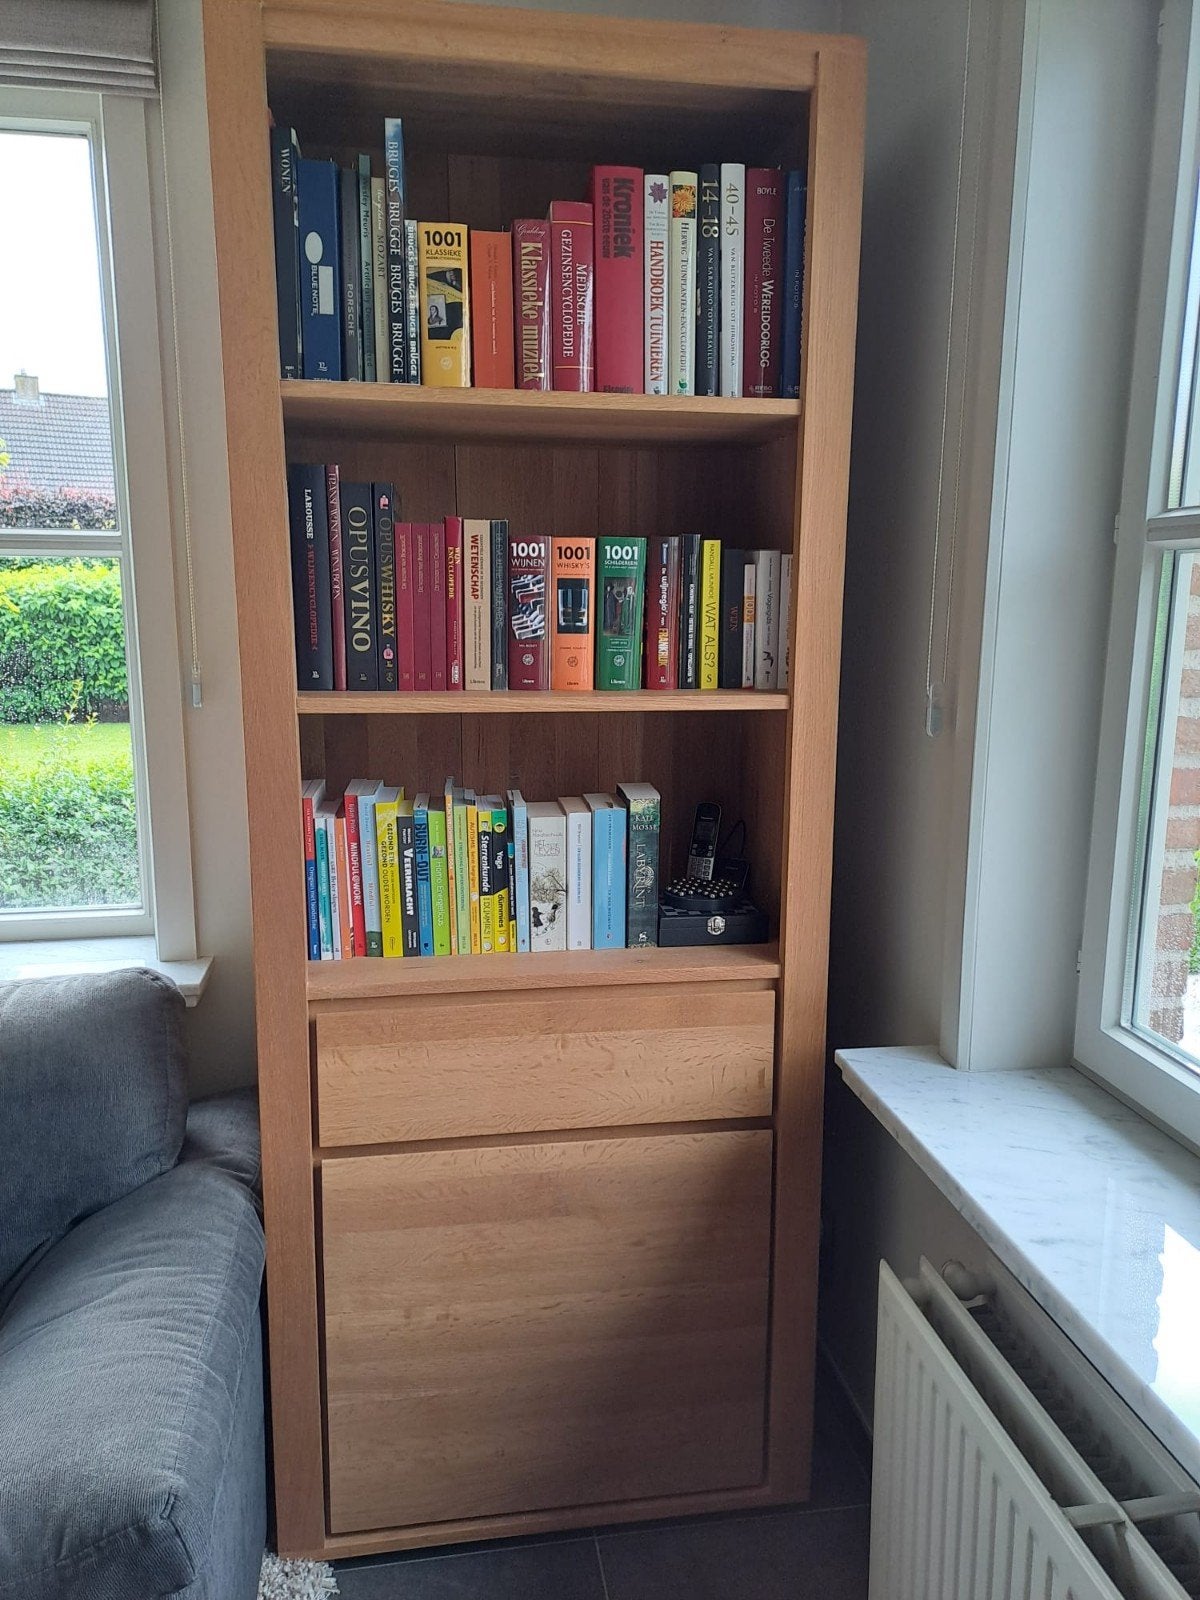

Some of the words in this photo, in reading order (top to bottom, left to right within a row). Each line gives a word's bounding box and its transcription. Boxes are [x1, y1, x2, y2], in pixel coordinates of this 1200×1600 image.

[279, 148, 291, 193] WONEN
[387, 141, 399, 192] BRUGES
[602, 178, 610, 194] van
[602, 195, 611, 207] de
[701, 179, 719, 238] 14-18
[725, 182, 739, 236] 40-45
[756, 187, 777, 195] BOYLE
[388, 202, 401, 255] BRUGGE
[602, 208, 611, 233] 20ste
[613, 177, 635, 257] Kroniek
[680, 222, 689, 255] HERWIG
[763, 218, 775, 233] De
[377, 235, 385, 280] MOZART
[424, 231, 462, 247] 1001
[426, 249, 462, 257] KLASSIEKE
[602, 235, 610, 258] eeuw
[762, 237, 774, 276] Tweede
[311, 265, 319, 288] BLUE
[364, 261, 372, 303] Artificially
[390, 264, 402, 313] BRUGES
[520, 242, 543, 319] Klassieke
[561, 229, 573, 357] GEZINSENCYCLOPEDIE
[575, 263, 587, 325] MEDISCHE
[650, 240, 664, 311] HANDBOEK
[311, 289, 319, 313] NOTE
[346, 283, 355, 336] PORSCHE
[409, 303, 417, 338] BRUGES
[680, 257, 689, 373] TUINPLANTEN-ENCYCLOPEDIE
[759, 279, 774, 367] WERELDOORLOG
[391, 322, 407, 374] BRÜGGE
[410, 341, 419, 376] BRÜGGE
[522, 325, 544, 382] muziek
[650, 314, 664, 381] TUINIEREN
[304, 489, 314, 539] LAROUSSE
[470, 534, 479, 600] WETENSCHAP
[511, 542, 545, 558] 1001
[511, 558, 545, 567] WIJNEN
[557, 546, 590, 560] 1001
[604, 545, 638, 560] 1001
[347, 506, 371, 652] OPUSVINO
[378, 517, 394, 637] OPUSWHISKY
[447, 546, 455, 599] ENCYCLOPEDIE
[308, 551, 318, 644] WIJNENCYCLOPEDIE
[658, 575, 668, 615] wijnregio's
[705, 601, 716, 631] WAT
[766, 593, 774, 624] Vogelgids
[496, 606, 504, 628] MENS
[658, 628, 668, 668] FRANKRIJK
[705, 634, 716, 668] ALS?
[350, 842, 361, 906] MINDFUL@WORK
[415, 823, 428, 883] BURN-OUT
[480, 835, 490, 893] Sterrenkunde
[495, 850, 504, 870] Yoga
[403, 848, 414, 916] VEERKRACHT
[633, 844, 647, 907] LABYRINT
[436, 886, 445, 927] Energeticus
[483, 901, 491, 936] DUMMIES
[497, 894, 505, 928] dummies
